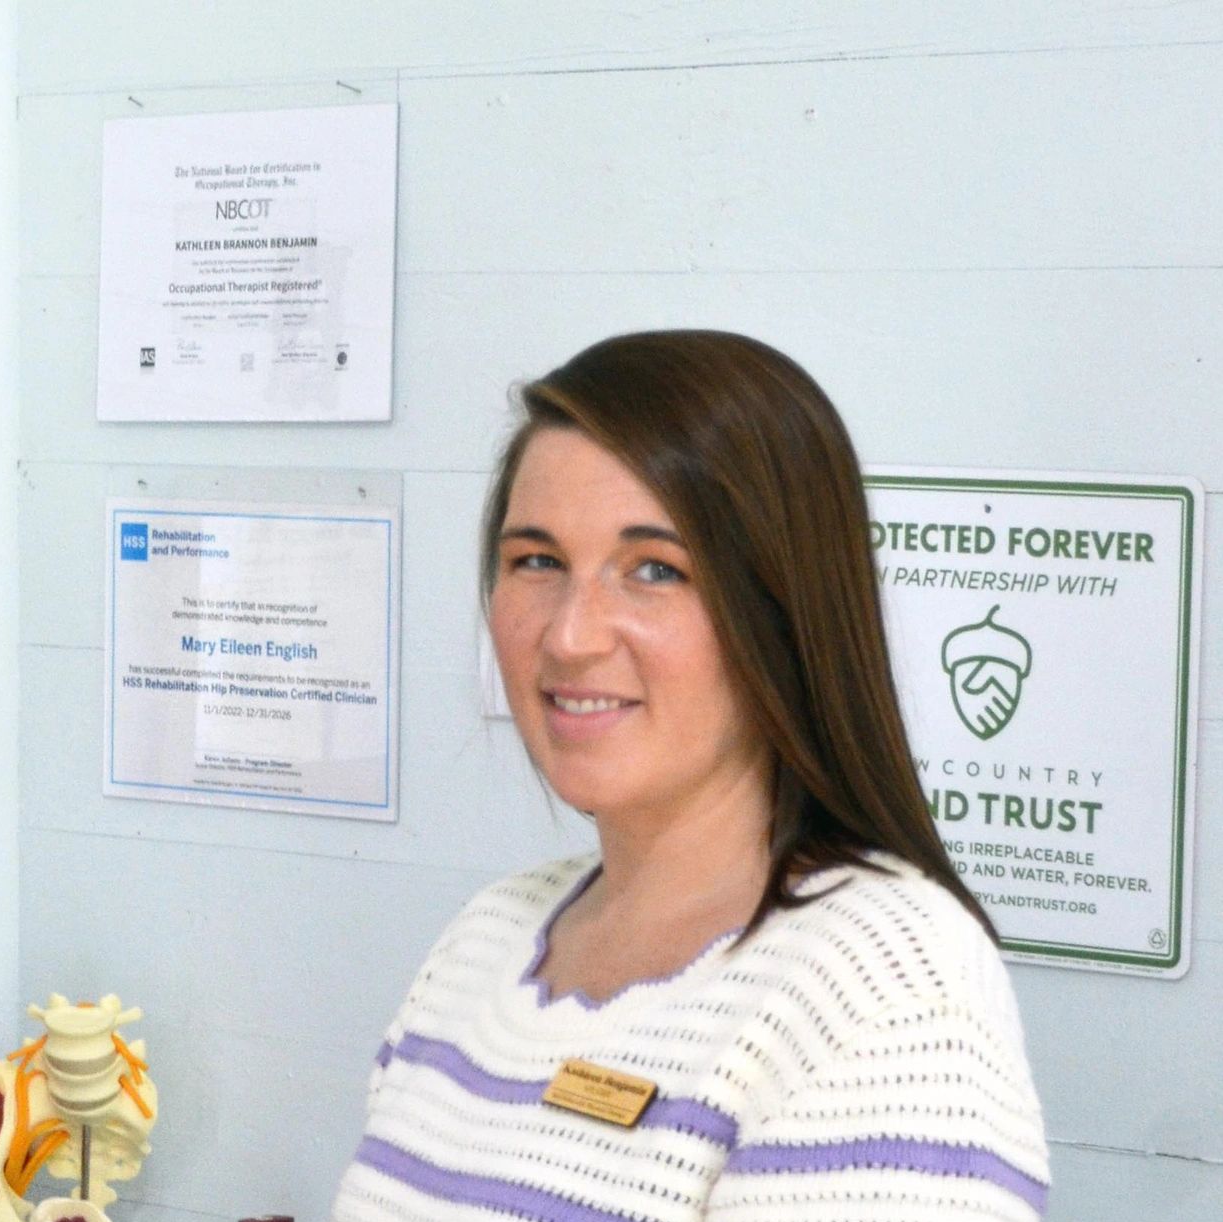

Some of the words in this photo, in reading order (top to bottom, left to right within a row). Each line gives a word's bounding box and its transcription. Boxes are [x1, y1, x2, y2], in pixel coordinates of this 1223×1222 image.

[216, 198, 273, 220] NBCOT
[175, 241, 221, 251] KATHLEEN
[224, 239, 268, 250] BRANNON
[270, 237, 318, 248] BENJAMIN
[169, 282, 226, 295] Occupational
[228, 281, 269, 293] Therapist
[123, 535, 146, 549] HSS
[152, 529, 215, 543] Rehabilitation
[870, 521, 996, 554] OTECTED
[1008, 527, 1154, 562] FOREVER
[152, 546, 169, 556] and
[171, 545, 230, 559] Performance
[893, 567, 1049, 594] PARTNERSHIP
[1056, 574, 1118, 598] WITH
[216, 599, 239, 611] certify
[241, 600, 256, 611] that
[266, 602, 308, 615] recognition
[310, 604, 318, 614] of
[172, 610, 224, 621] demonstrated
[225, 613, 264, 625] knowledge
[265, 615, 279, 625] and
[281, 617, 328, 628] competence
[181, 636, 216, 656] Mary
[220, 638, 262, 656] Eileen
[266, 640, 318, 662] English
[129, 665, 142, 674] has
[222, 670, 234, 679] the
[236, 671, 286, 684] requirements
[287, 675, 295, 684] to
[296, 676, 306, 685] be
[307, 677, 349, 690] recognized
[351, 680, 359, 688] as
[361, 681, 371, 689] an
[122, 677, 143, 688] HSS
[145, 678, 208, 692] Rehabilitation
[211, 683, 228, 696] Hip
[229, 684, 288, 699] Preservation
[290, 688, 333, 702] Certified
[335, 691, 378, 705] Clinician
[917, 759, 1103, 787] WCOUNTRY
[977, 792, 1103, 834] TRUST
[969, 842, 1095, 866] IRREPLACEABLE
[973, 863, 1006, 878] AND
[1011, 866, 1069, 887] WATER,
[1074, 873, 1153, 893] FOREVER.
[976, 891, 1097, 914] RYLANDTRUST.ORG
